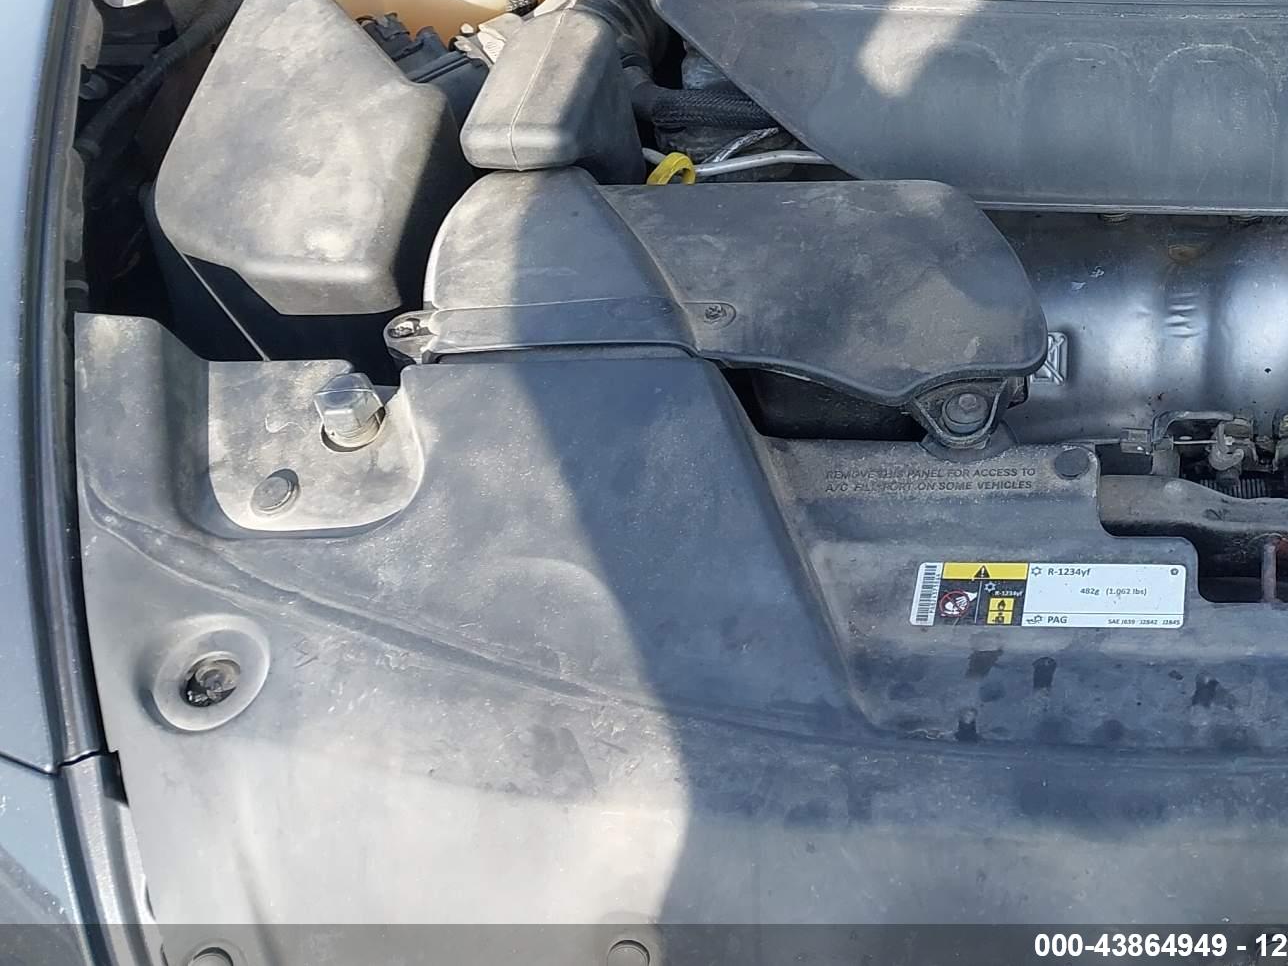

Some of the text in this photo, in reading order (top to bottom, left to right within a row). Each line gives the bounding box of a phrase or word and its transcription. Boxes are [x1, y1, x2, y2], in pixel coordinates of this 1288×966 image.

[947, 469, 970, 478] FOR
[973, 468, 1018, 477] ACCESS
[1022, 468, 1036, 477] TO
[825, 482, 849, 493] A/C
[918, 482, 937, 491] ON
[939, 482, 972, 491] SOME
[977, 481, 1032, 490] VEHICLES
[1047, 567, 1091, 577] R-1234yf
[1079, 588, 1100, 596] 482g
[1132, 587, 1147, 596] lbs)
[1047, 615, 1068, 624] PAG
